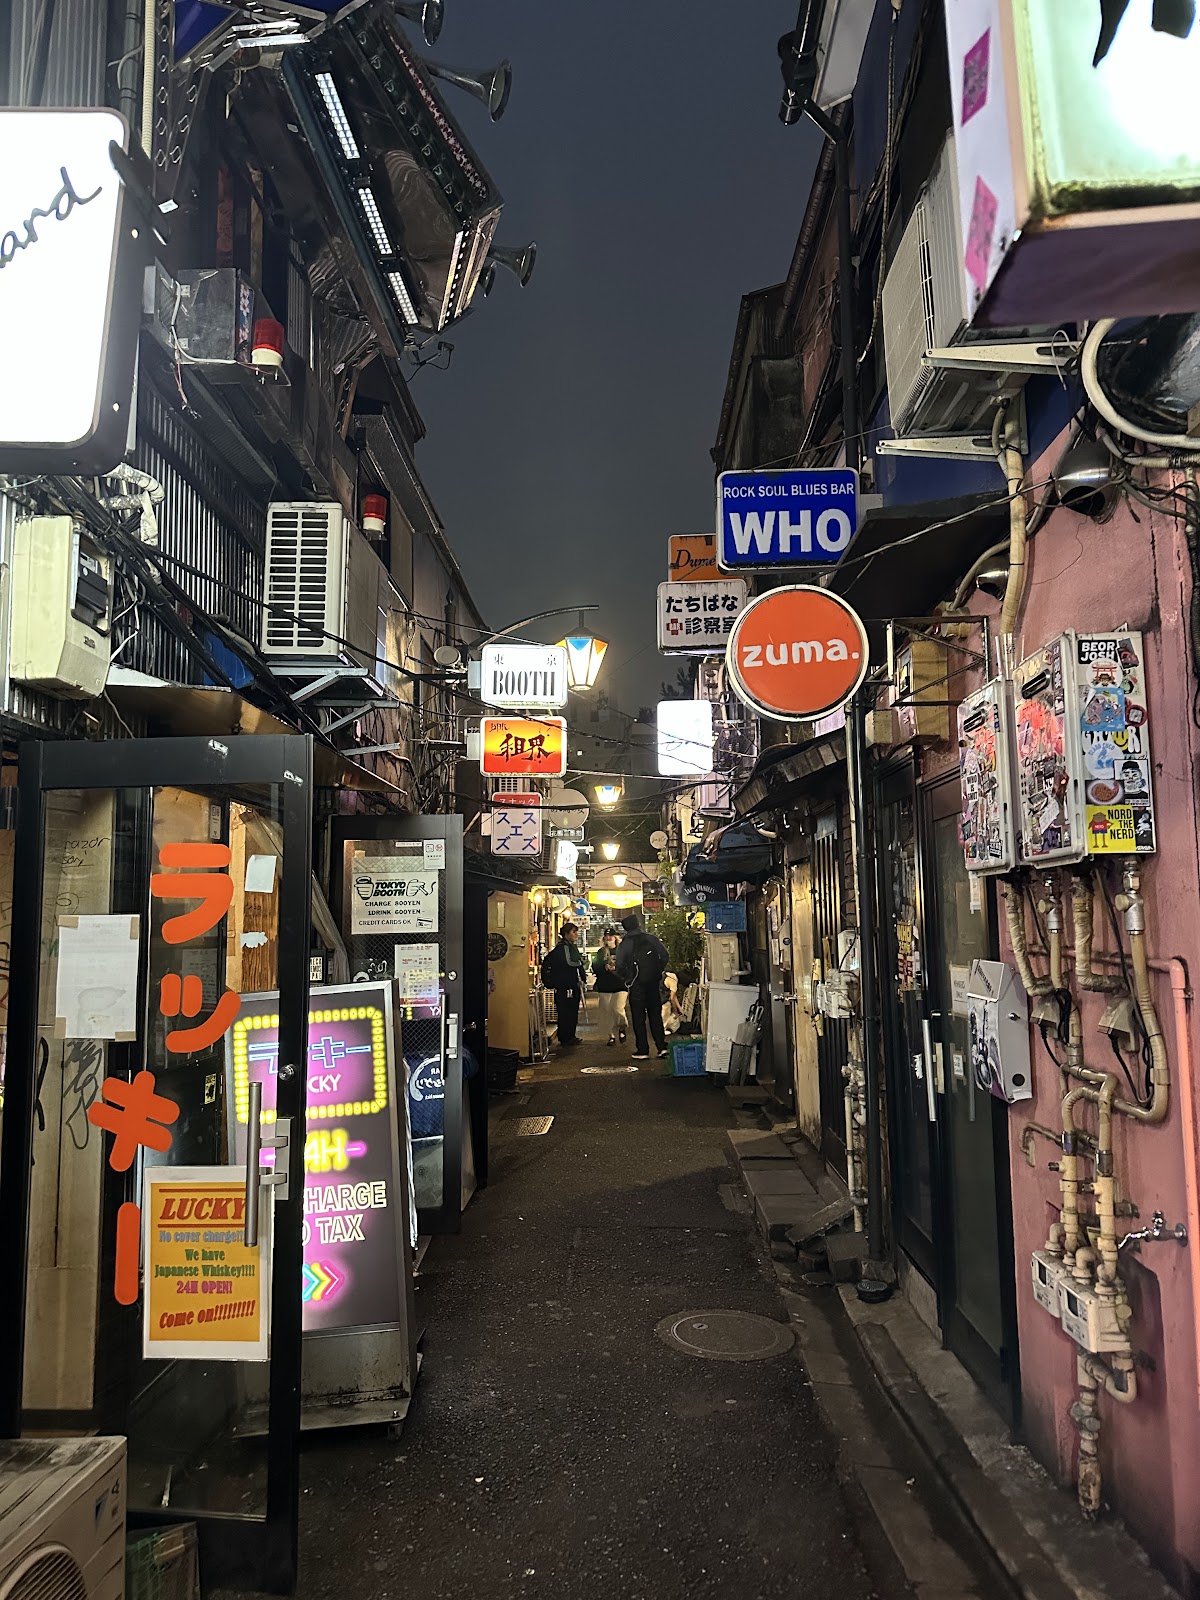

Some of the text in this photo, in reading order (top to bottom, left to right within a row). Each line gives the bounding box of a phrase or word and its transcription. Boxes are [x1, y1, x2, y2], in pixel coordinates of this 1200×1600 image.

[723, 482, 855, 499] ROCK SOUL BLUES BAR
[729, 508, 852, 555] WHO
[666, 594, 738, 613] たちばな
[685, 617, 737, 636] 診察室
[742, 637, 860, 669] zuma.
[1081, 641, 1116, 652] BEOR
[1080, 651, 1115, 662] JOSH
[492, 670, 556, 697] BOOTH
[1107, 808, 1133, 820] NORD
[1119, 819, 1134, 829] THE
[1109, 829, 1135, 840] NERD
[375, 881, 407, 889] TOKYO
[372, 889, 406, 897] BOOTH
[381, 918, 402, 926] CARDS
[308, 1073, 342, 1094] CKY
[304, 1134, 344, 1170] 4H
[305, 1180, 388, 1216] HARGE
[159, 1197, 248, 1221] LUCKY
[159, 1230, 172, 1243] No
[174, 1231, 201, 1243] cover
[315, 1213, 366, 1245] TAX
[185, 1248, 226, 1261] We have
[155, 1264, 199, 1278] Japanese
[177, 1280, 198, 1294] 24H
[159, 1310, 195, 1329] Come
